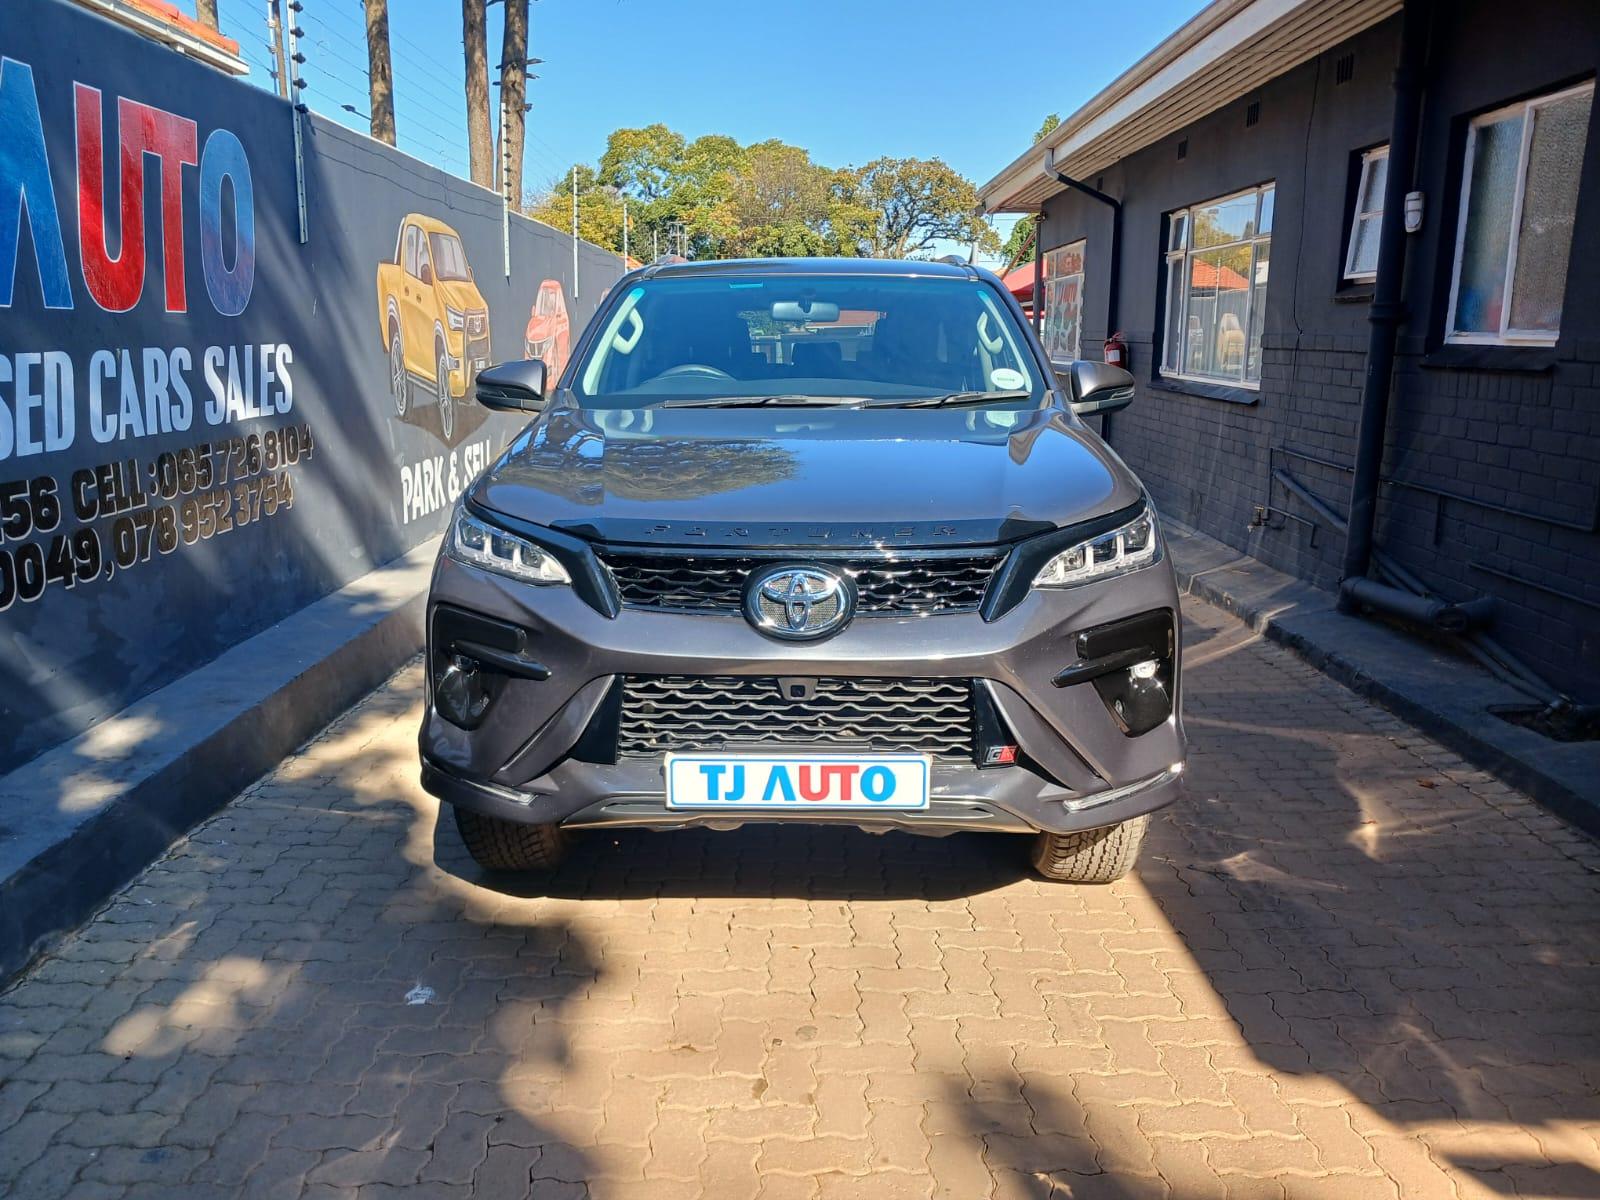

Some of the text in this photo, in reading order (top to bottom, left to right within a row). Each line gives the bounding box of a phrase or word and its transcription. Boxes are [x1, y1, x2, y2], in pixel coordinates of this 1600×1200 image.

[0, 56, 256, 317] AUTO
[89, 347, 193, 443] CARS
[203, 343, 293, 426] SALES
[0, 474, 61, 544] 56
[400, 456, 446, 524] PARK
[448, 451, 461, 503] &
[699, 765, 897, 801] TJ AUTO
